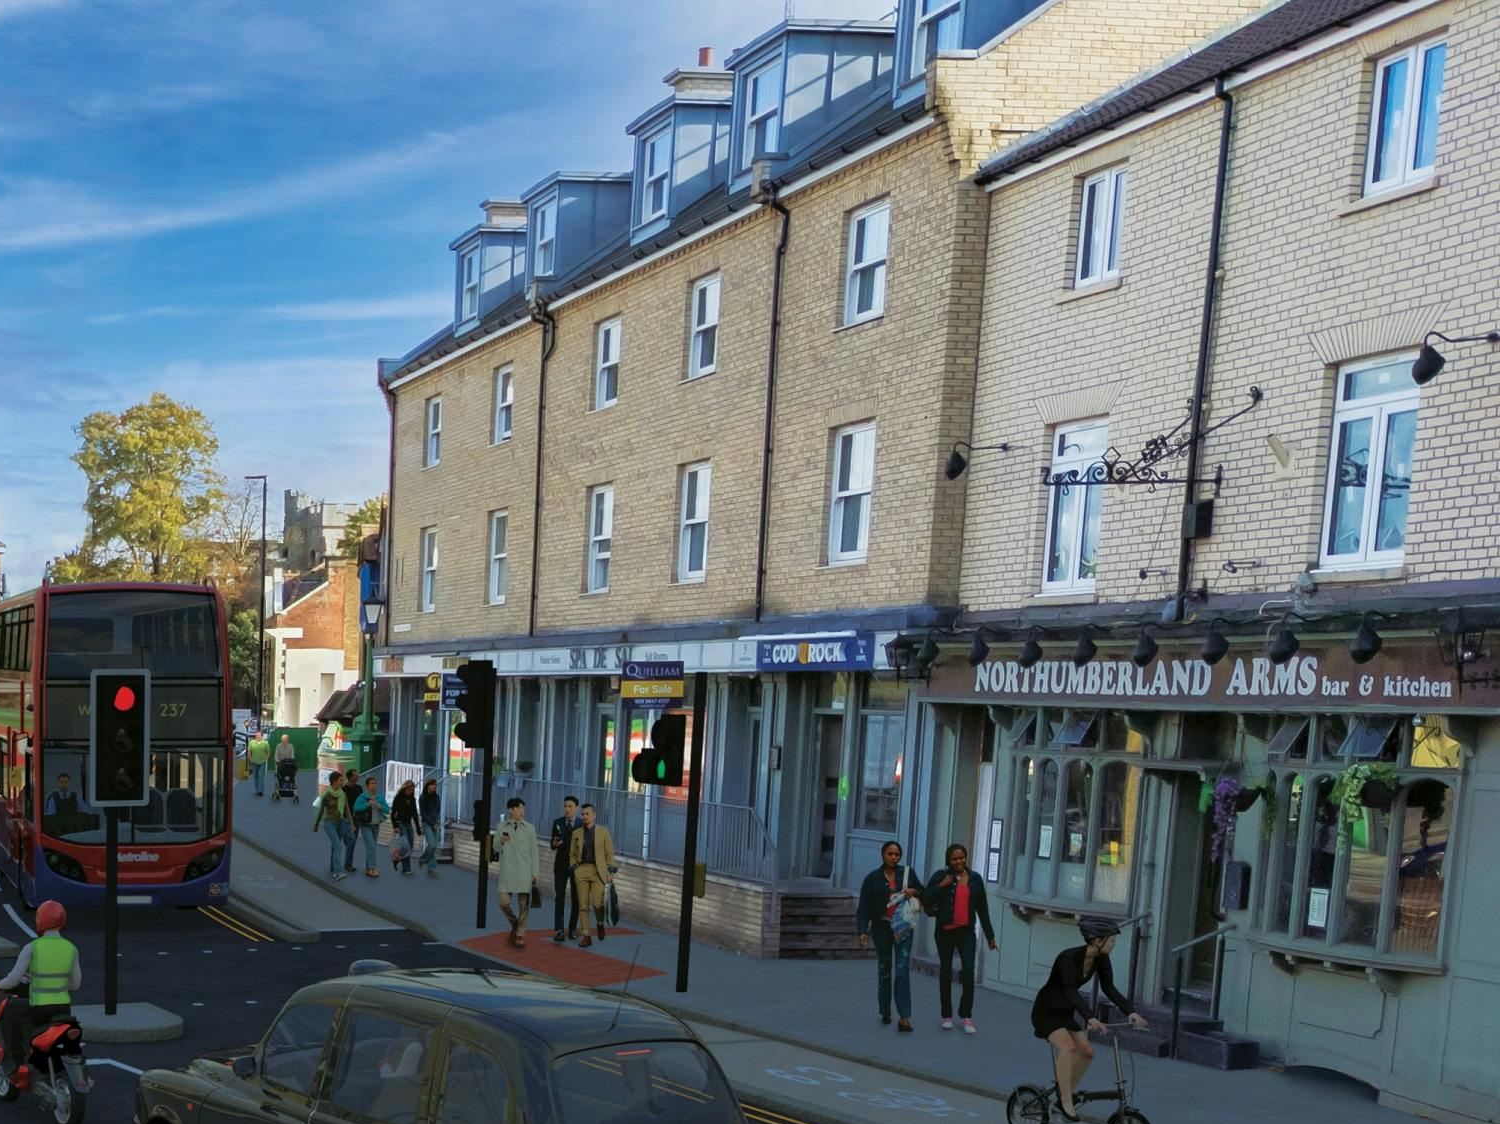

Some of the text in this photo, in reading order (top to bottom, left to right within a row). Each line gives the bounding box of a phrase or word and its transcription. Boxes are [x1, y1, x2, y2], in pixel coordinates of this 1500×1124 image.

[570, 648, 586, 669] SPA
[594, 648, 607, 669] DE
[772, 644, 795, 664] COD
[808, 642, 845, 663] ROCK
[975, 656, 1452, 697] NORTHUMBERLAND ARMS bar & kitchen
[633, 684, 673, 694] For Sale
[159, 703, 187, 717] 237
[117, 851, 160, 863] etroline
